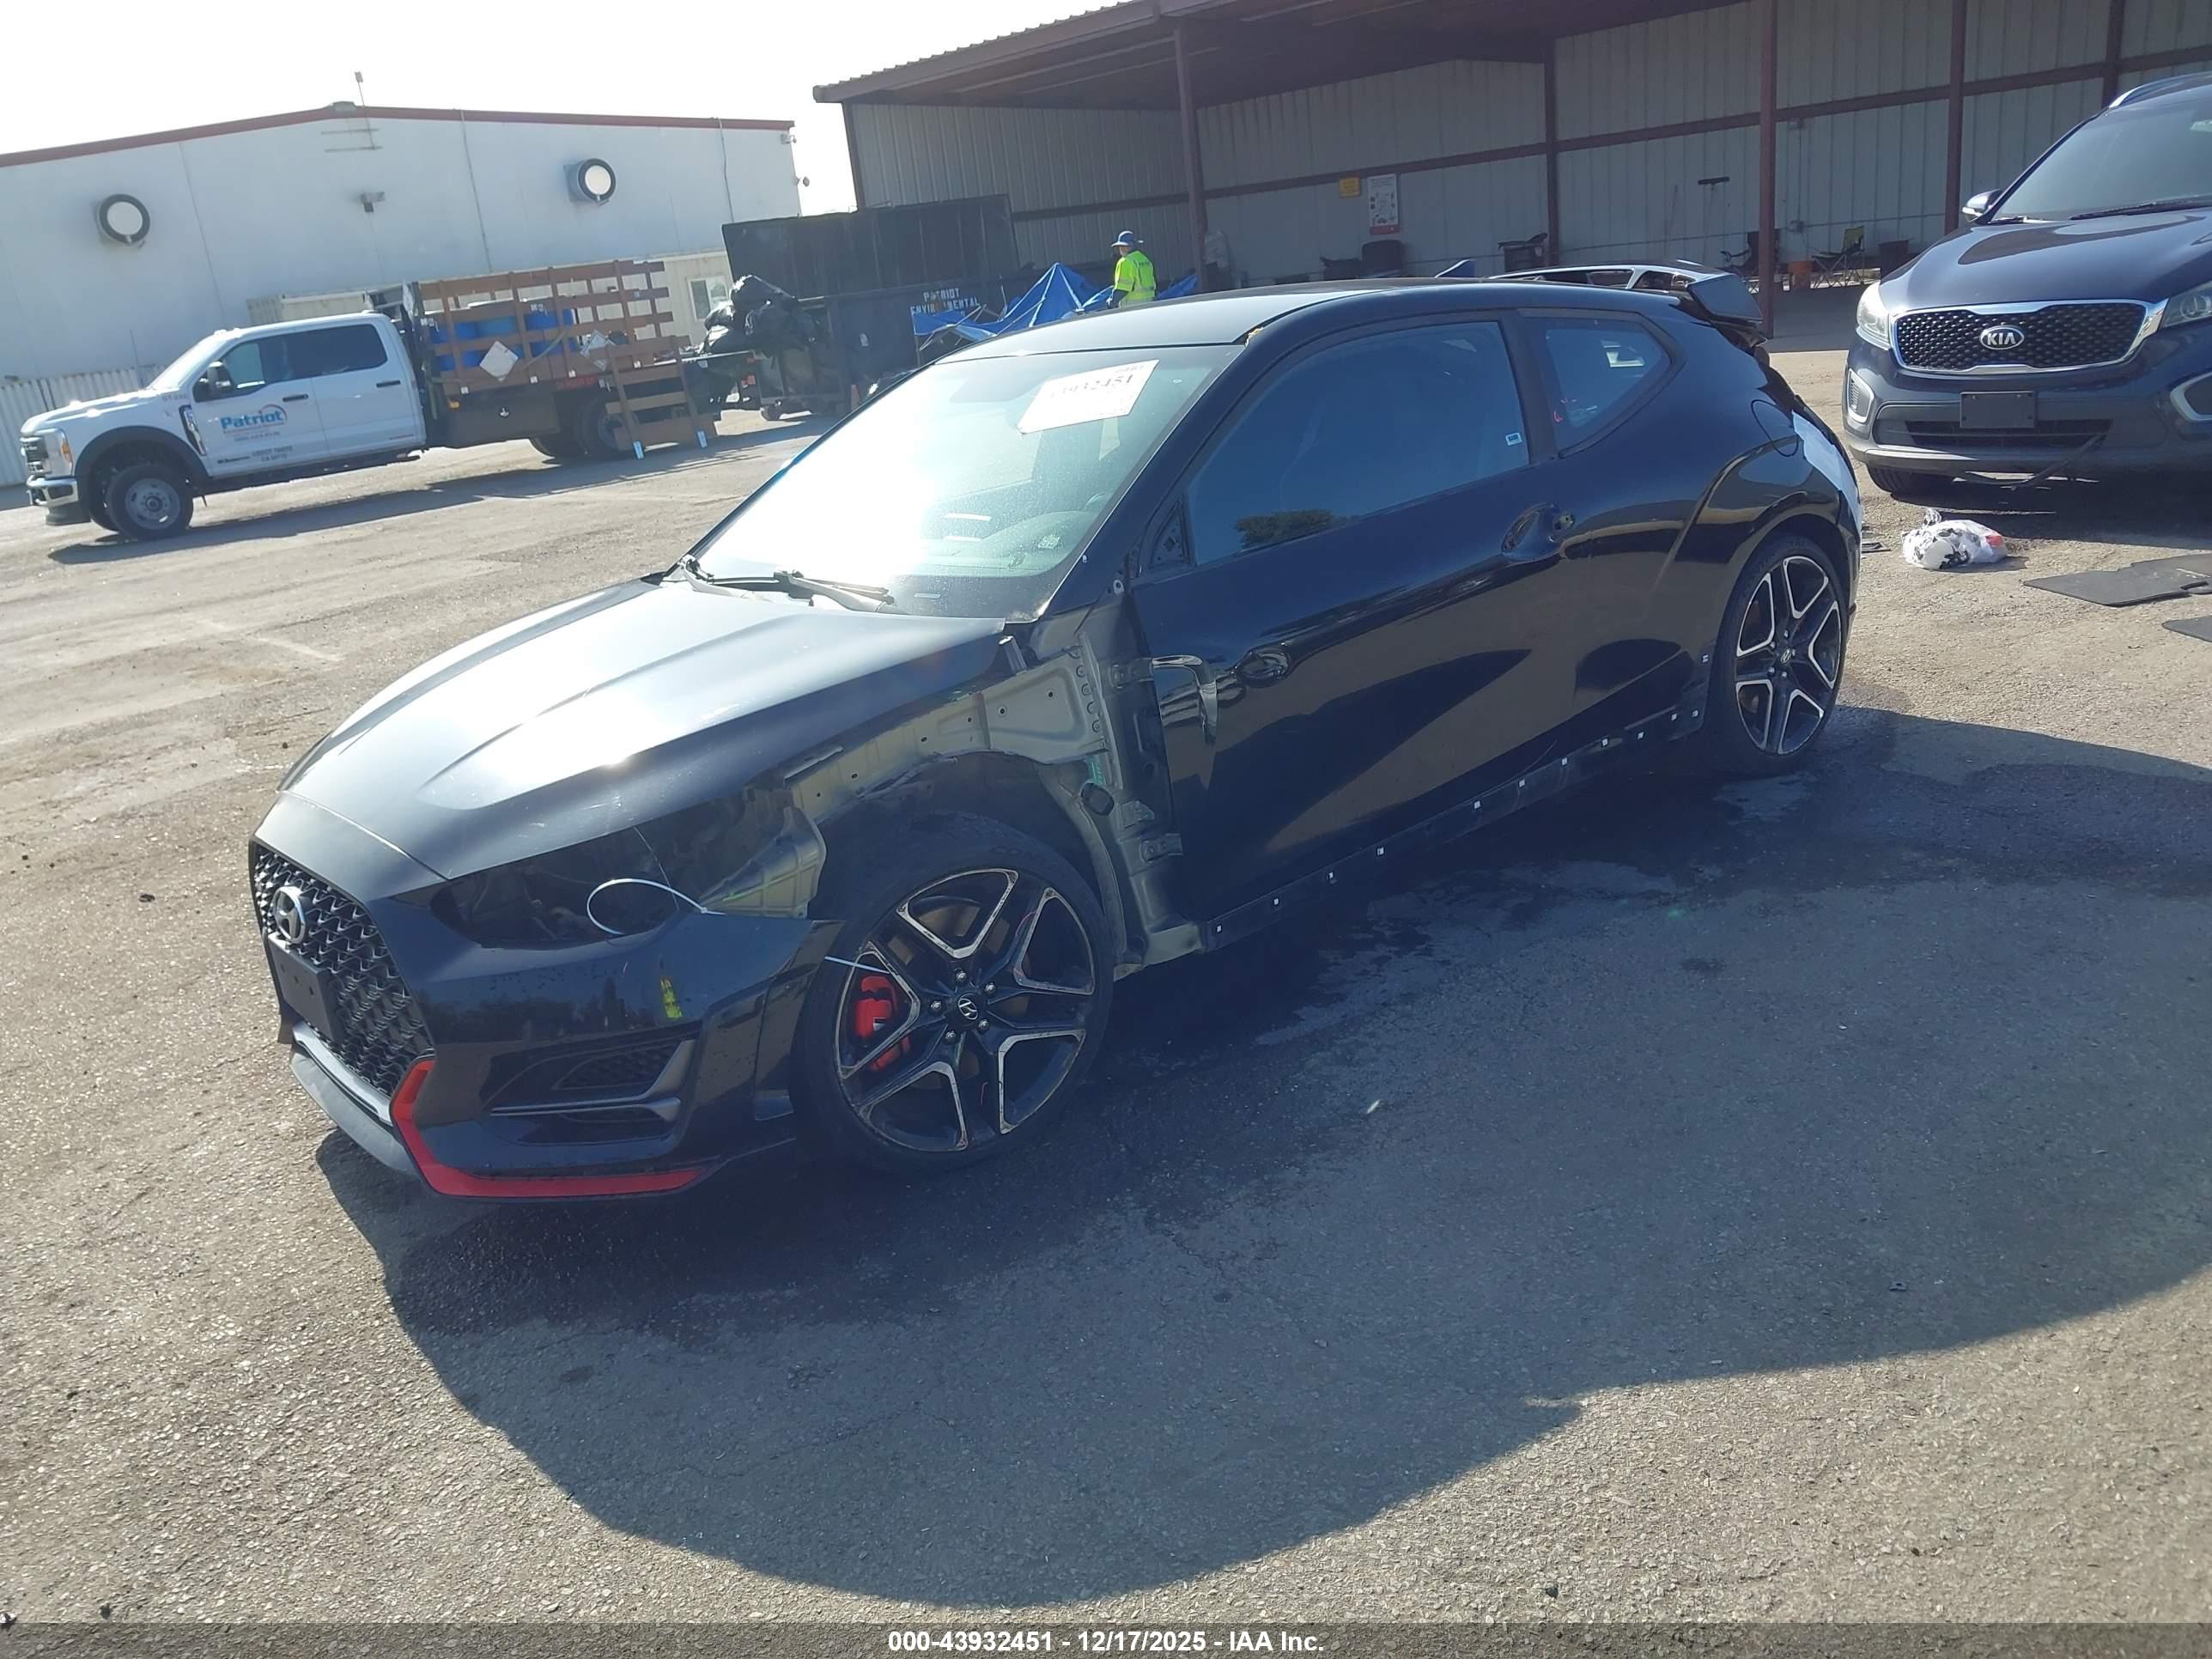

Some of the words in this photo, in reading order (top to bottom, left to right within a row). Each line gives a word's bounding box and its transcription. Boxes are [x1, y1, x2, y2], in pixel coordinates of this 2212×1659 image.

[909, 296, 981, 315] ENVIRMENTAL
[1987, 332, 2016, 345] KIA
[221, 410, 283, 429] Patriot
